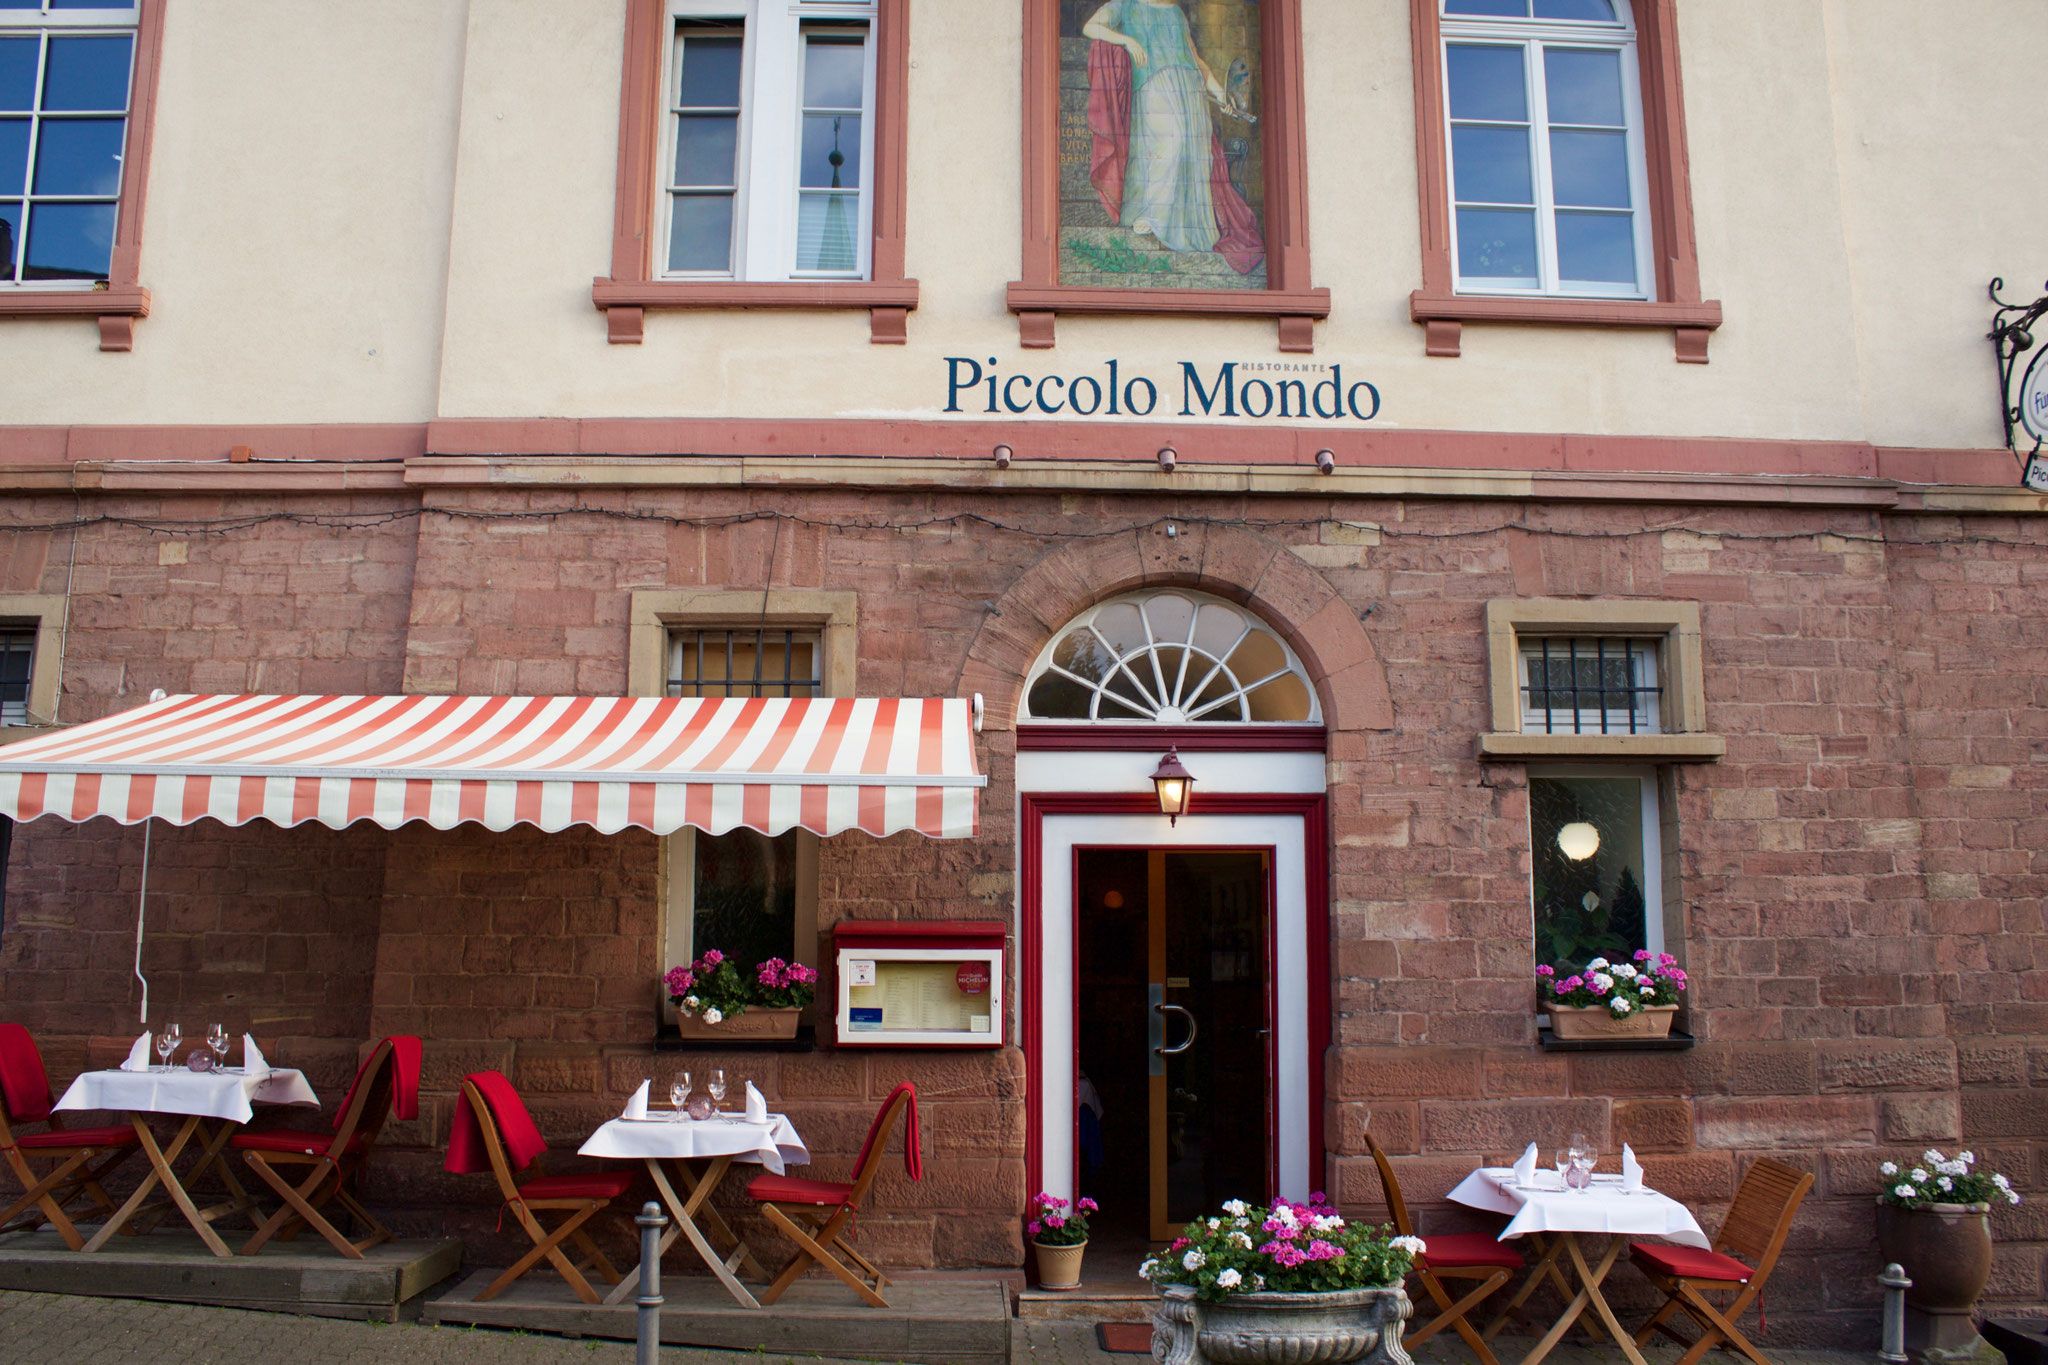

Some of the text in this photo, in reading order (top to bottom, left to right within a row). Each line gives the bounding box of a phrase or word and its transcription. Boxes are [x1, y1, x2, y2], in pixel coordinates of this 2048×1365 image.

[1065, 139, 1088, 150] VITA
[1241, 362, 1326, 373] RISTORANTE
[942, 356, 1381, 421] Piccolo Mondo
